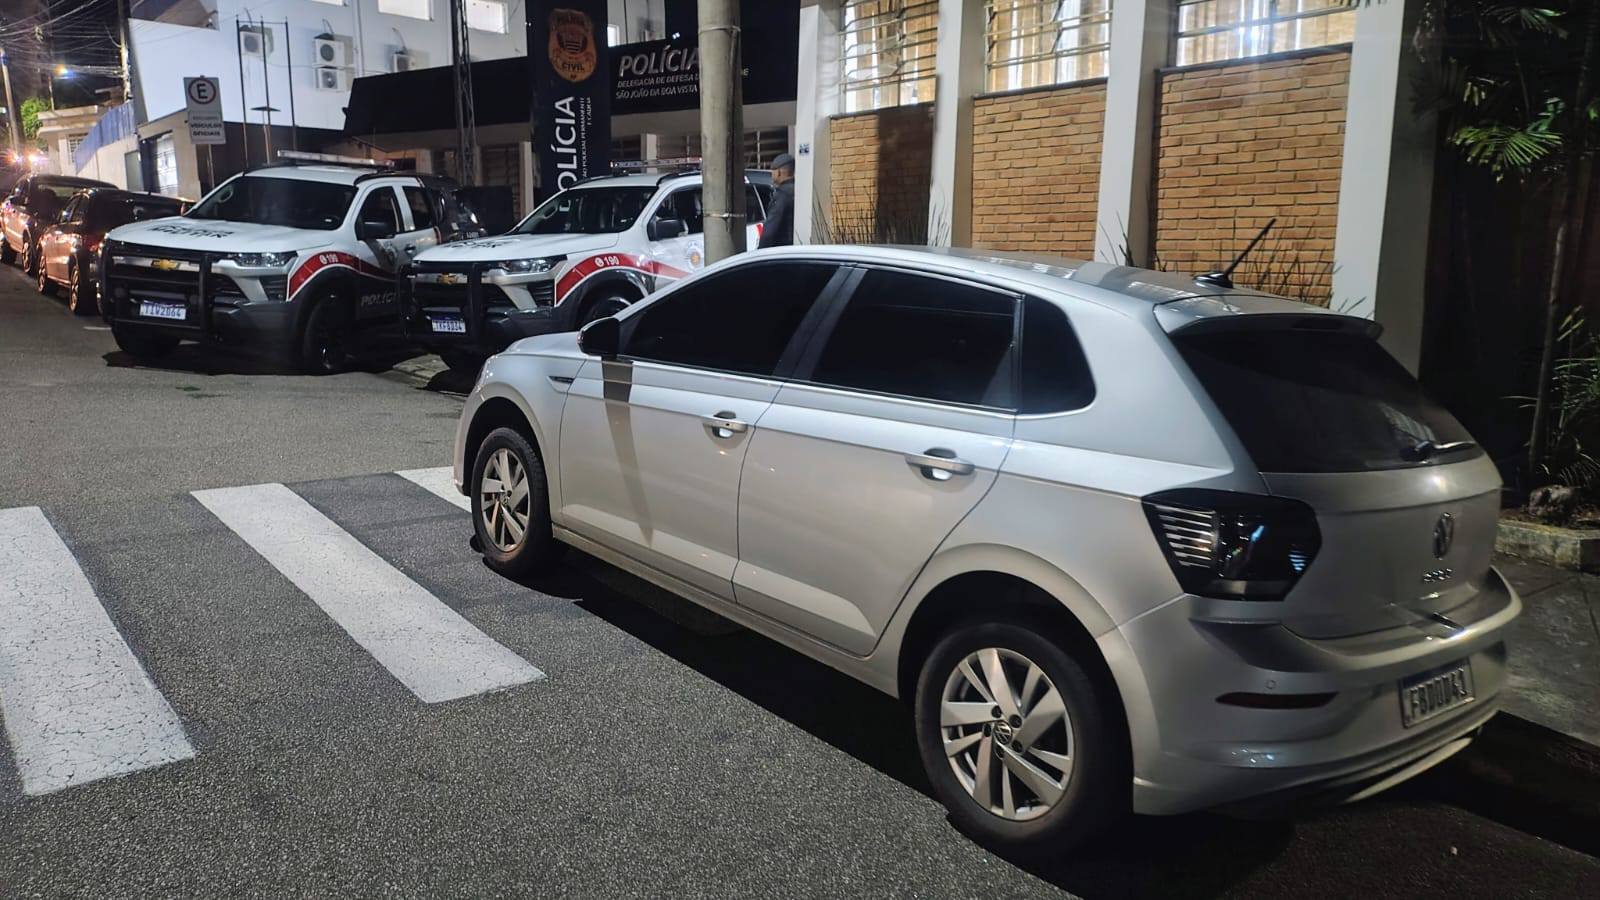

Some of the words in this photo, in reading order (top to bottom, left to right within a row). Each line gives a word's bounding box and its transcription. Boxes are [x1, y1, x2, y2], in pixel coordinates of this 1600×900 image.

[561, 63, 585, 71] CIVIL
[617, 78, 655, 88] DELEGACIA
[656, 76, 665, 85] DE
[666, 74, 694, 83] DEFESA
[196, 83, 209, 99] E
[650, 87, 661, 96] DA
[661, 85, 677, 96] BOA
[677, 84, 698, 94] VISTA
[551, 96, 578, 191] OLÍCIA
[604, 255, 620, 266] 190
